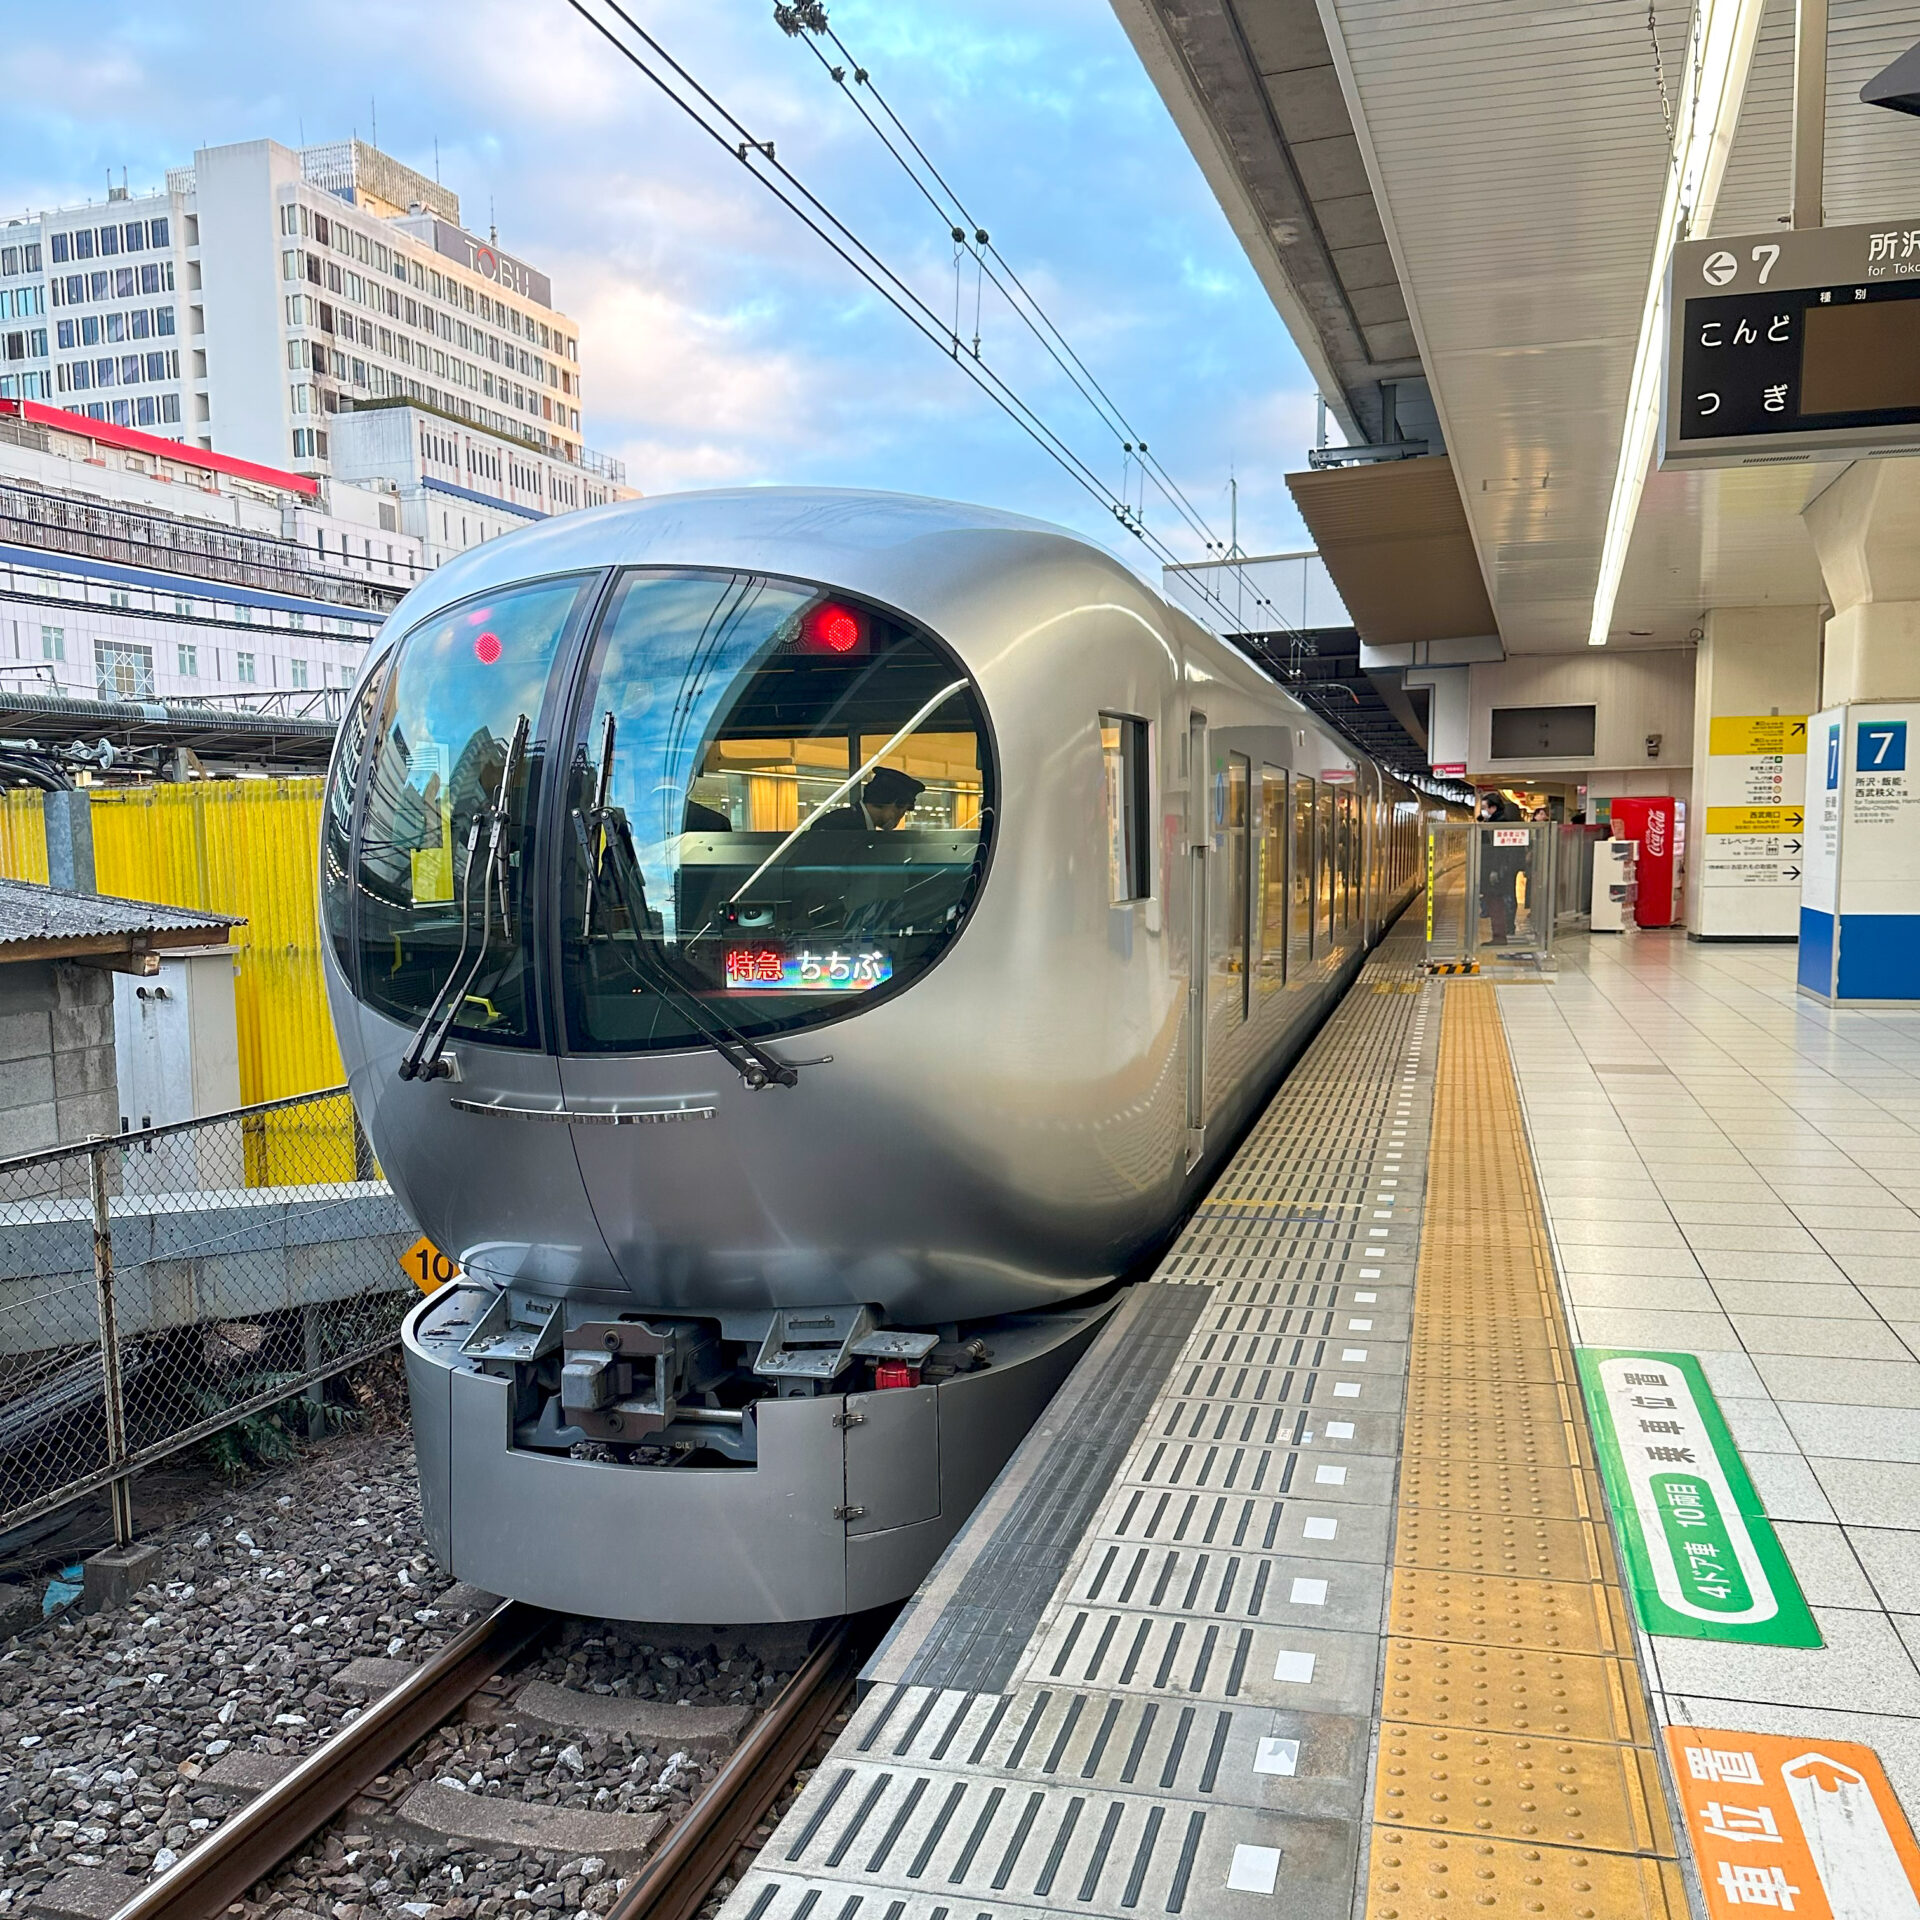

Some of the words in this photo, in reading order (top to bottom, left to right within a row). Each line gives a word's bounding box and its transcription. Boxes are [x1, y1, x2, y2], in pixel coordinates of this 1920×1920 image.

[464, 239, 529, 299] TOBU
[1751, 244, 1781, 285] 7
[1868, 265, 1886, 277] for
[1700, 314, 1790, 347] こんど
[1697, 383, 1789, 416] つぎ
[1870, 732, 1895, 764] 7
[1646, 808, 1666, 857] Coca-Cola
[728, 950, 784, 982] 特急
[797, 950, 883, 981] ちちぶ
[416, 1249, 454, 1283] 10
[1623, 1373, 1696, 1463] 乗車位置
[1664, 1483, 1708, 1528] 10両目
[1683, 1541, 1731, 1599] 4ドア車
